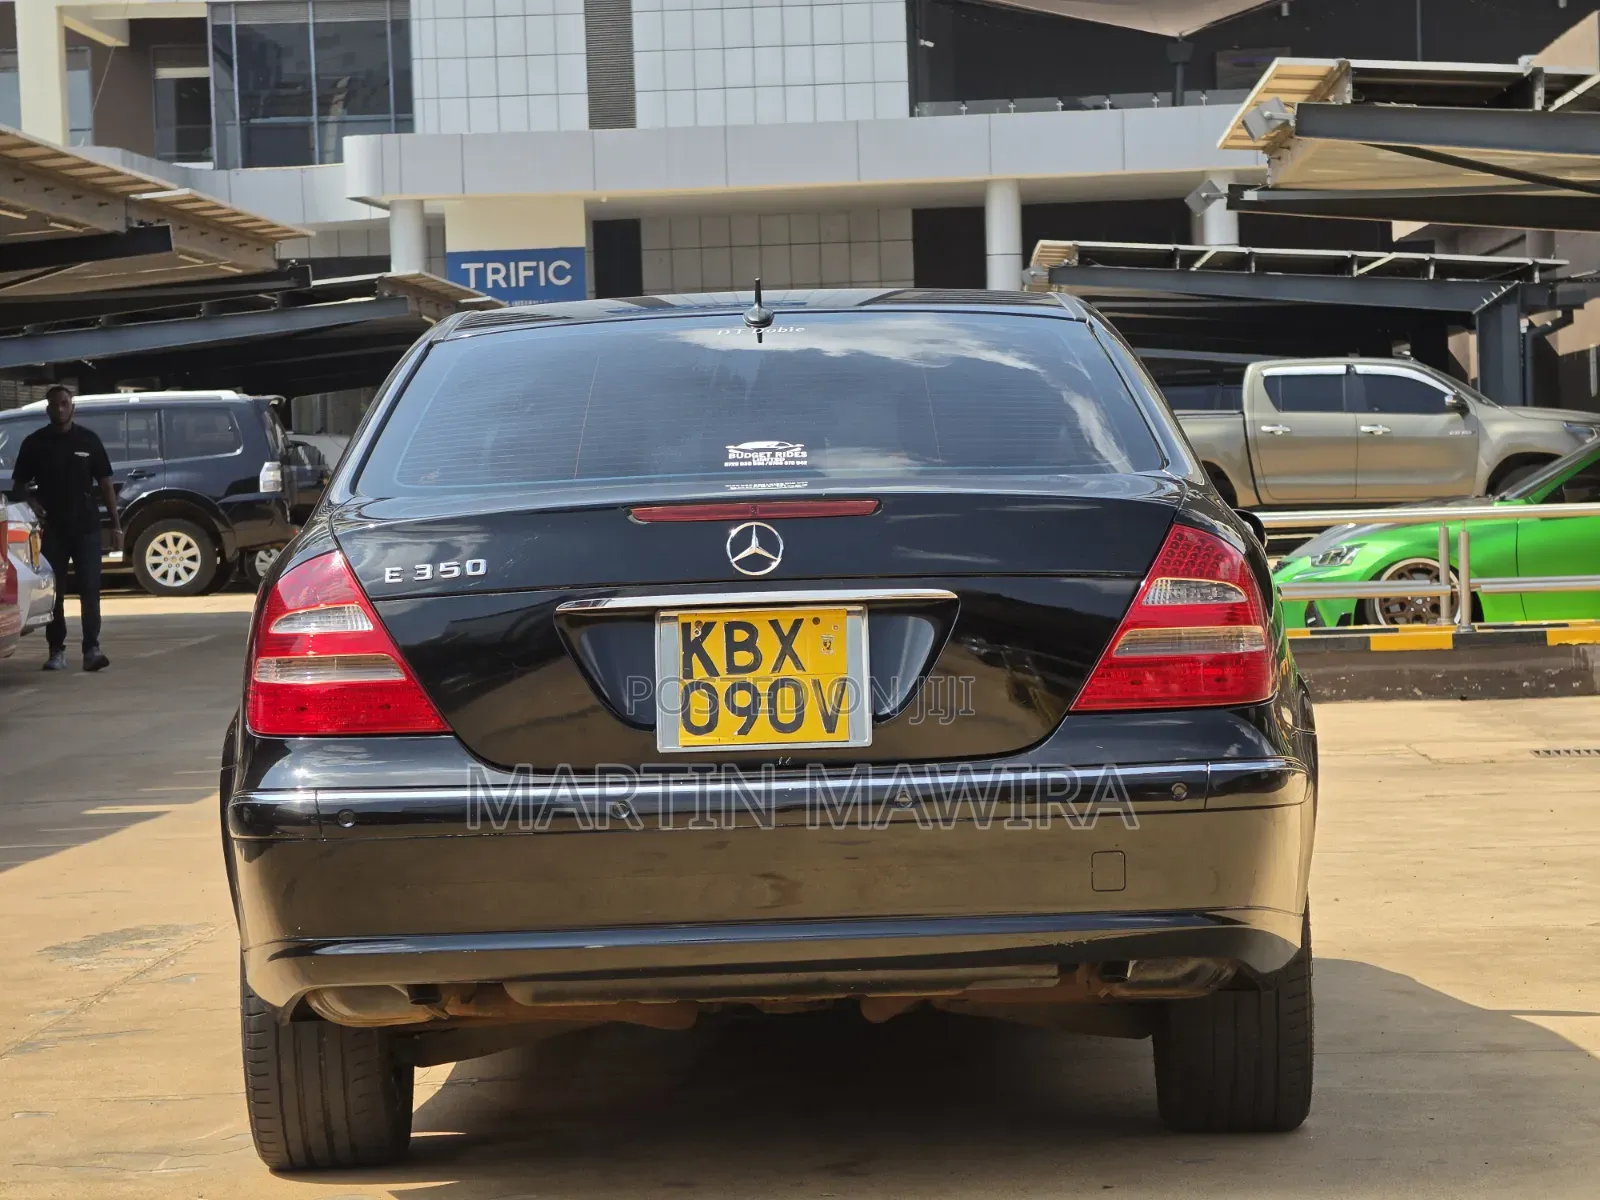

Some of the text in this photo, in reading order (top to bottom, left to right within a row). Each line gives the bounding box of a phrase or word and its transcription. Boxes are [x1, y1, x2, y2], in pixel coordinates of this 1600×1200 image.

[461, 260, 573, 289] TRIFIC
[728, 451, 773, 460] BUDGET
[384, 559, 488, 584] E 350
[681, 618, 807, 680] KBX
[681, 677, 848, 737] 090V
